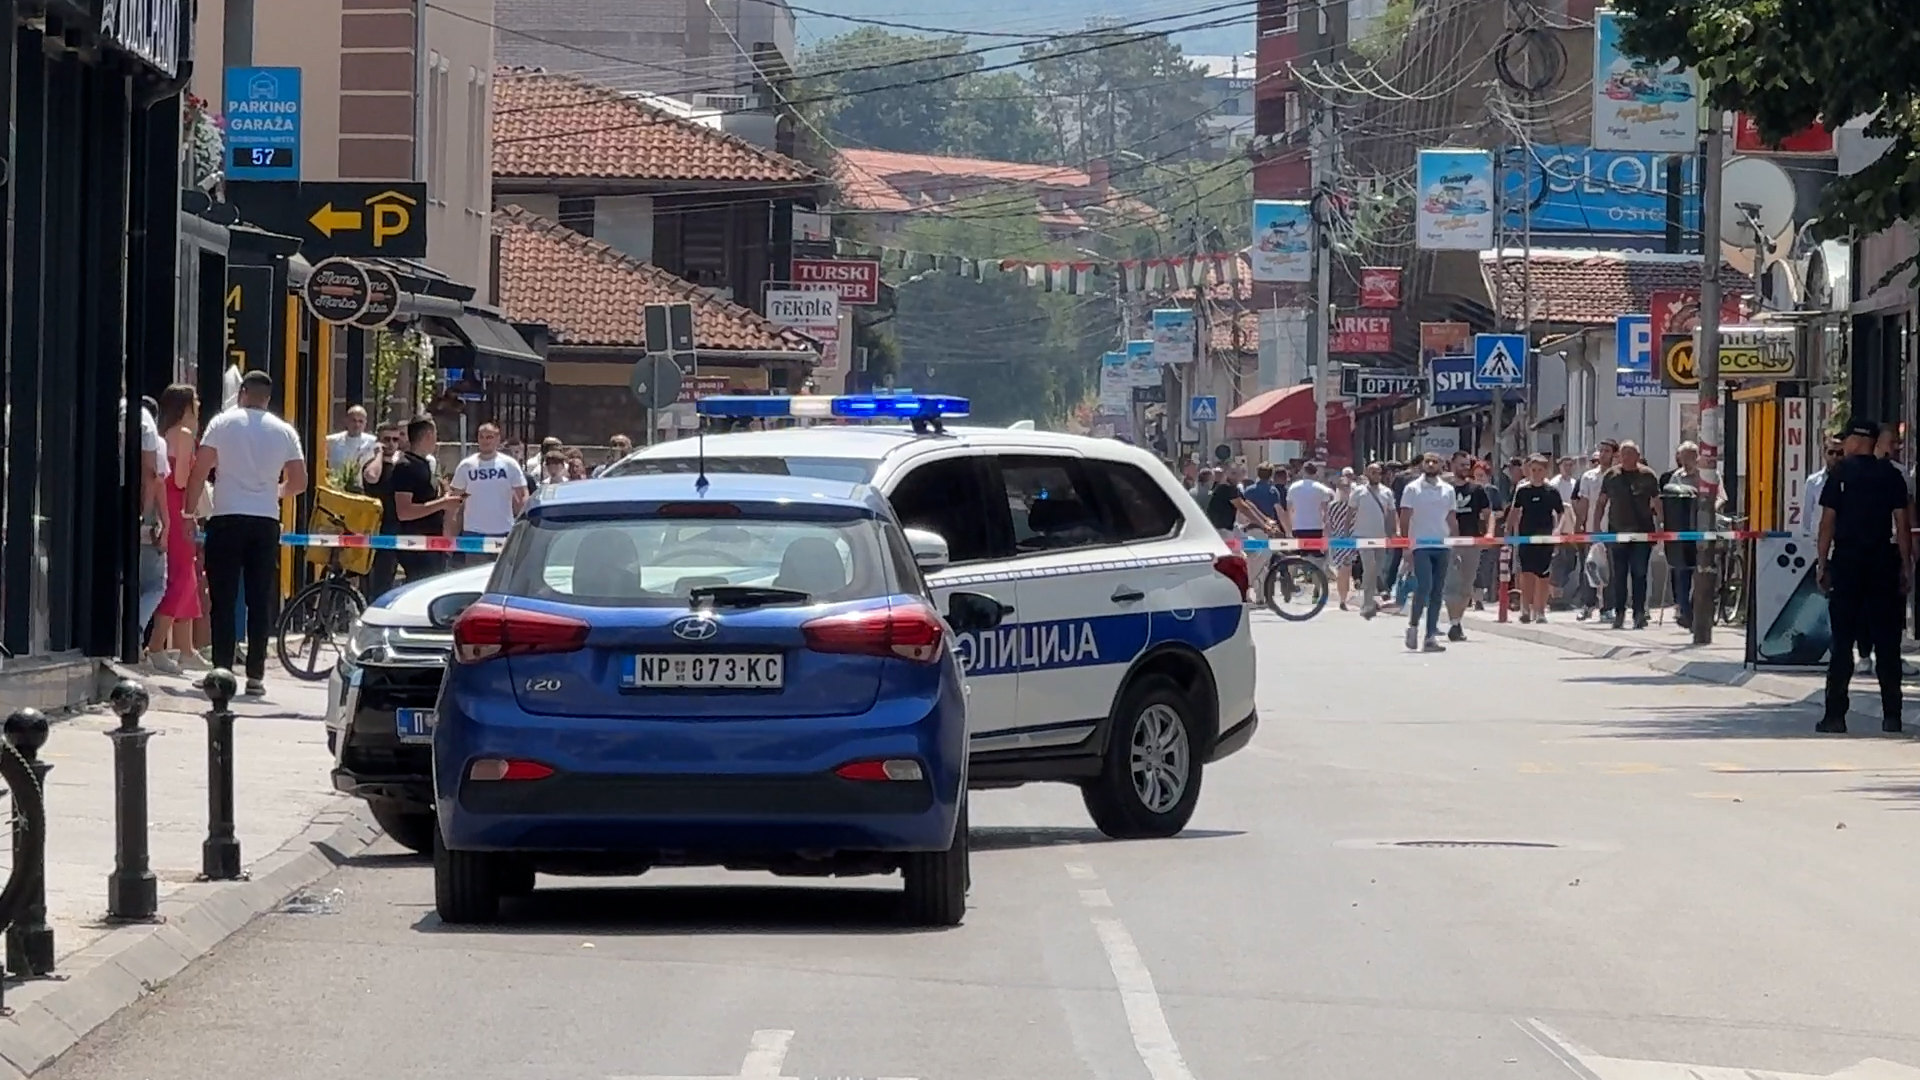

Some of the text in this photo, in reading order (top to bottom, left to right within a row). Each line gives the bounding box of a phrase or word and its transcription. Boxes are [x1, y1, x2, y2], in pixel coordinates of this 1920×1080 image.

[229, 101, 297, 114] PARKING
[231, 116, 294, 131] GARAŽA
[252, 149, 275, 165] 57
[316, 271, 360, 286] Mama
[799, 265, 870, 280] TURSKI
[1336, 317, 1390, 333] ARKET
[1366, 379, 1421, 394] OPTIKA
[468, 468, 508, 481] USPA
[955, 621, 1100, 672] ОЛИЦИЈА
[640, 658, 670, 681] NP
[525, 679, 561, 691] i20
